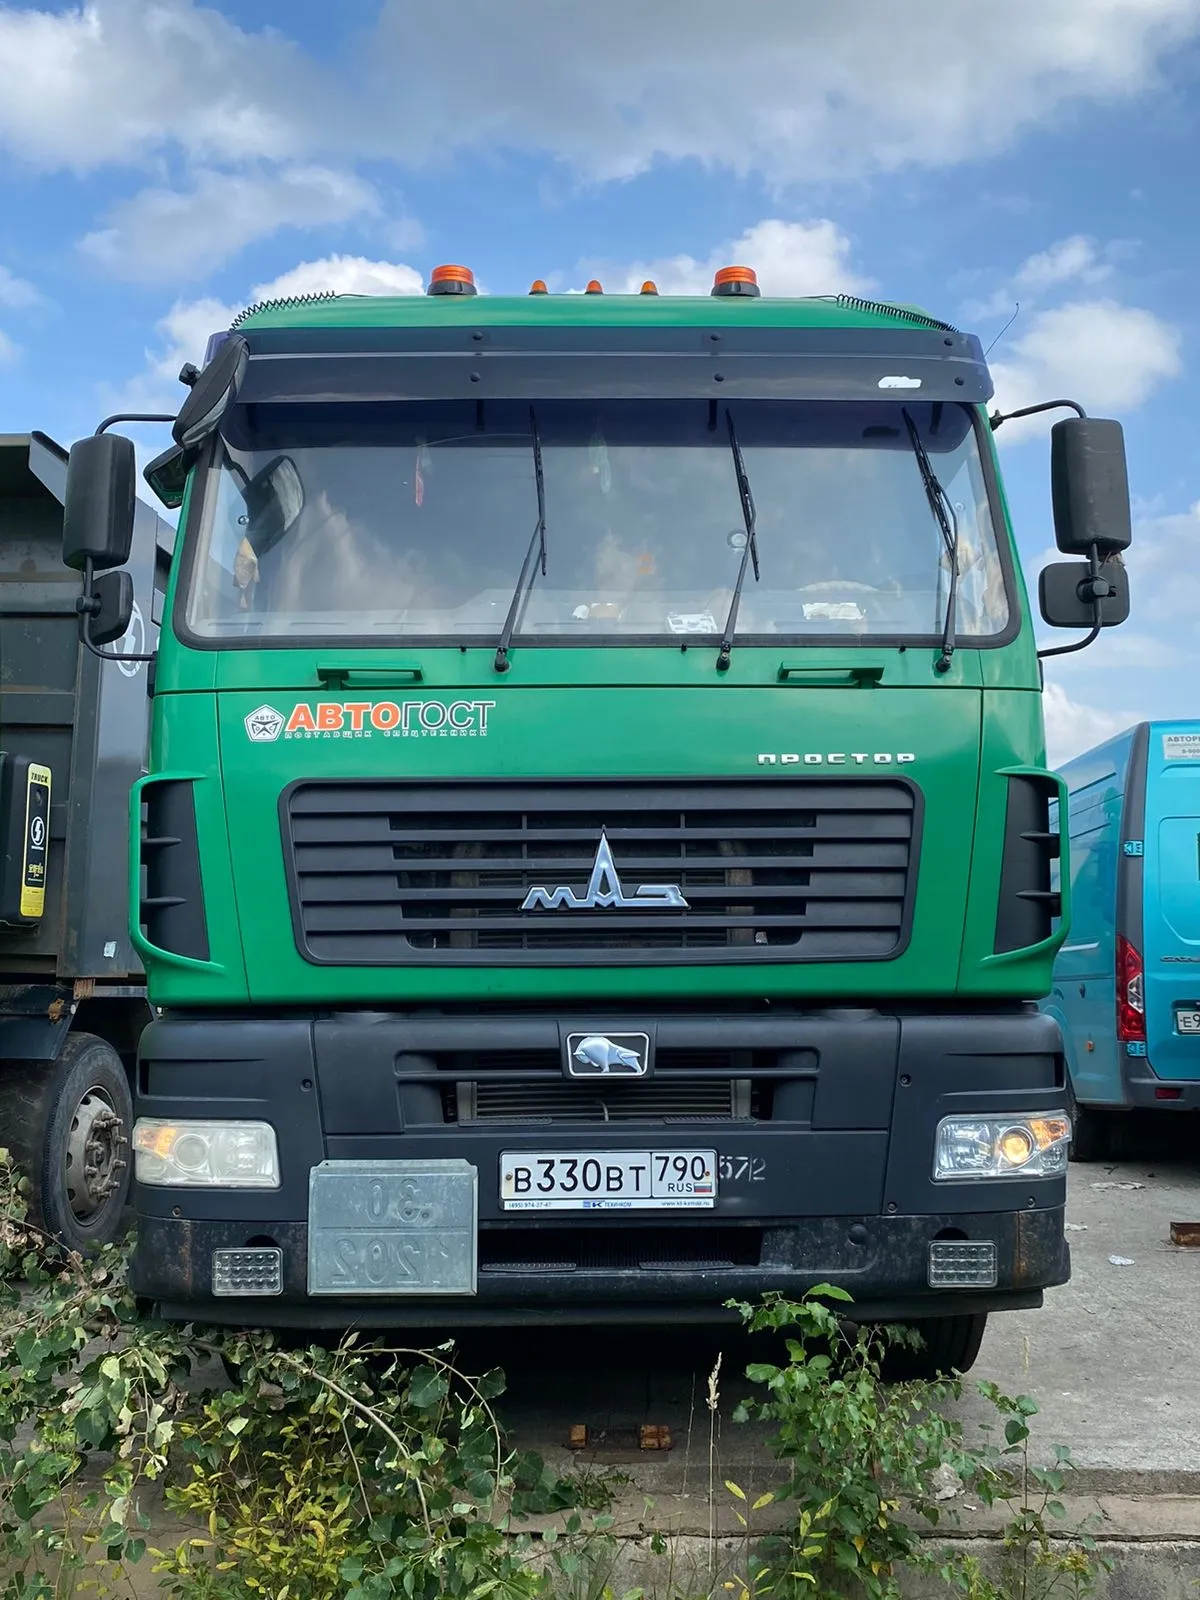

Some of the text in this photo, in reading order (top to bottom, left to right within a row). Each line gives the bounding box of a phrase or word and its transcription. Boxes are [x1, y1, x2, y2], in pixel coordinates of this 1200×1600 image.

[284, 701, 496, 731] АВТОГОСТ
[284, 729, 488, 740] ПОСТАВЩИК СПЕЦТЕХНИКИ
[757, 752, 916, 766] ПРОСТОР
[520, 824, 690, 910] МАЗ
[513, 1155, 706, 1193] В330ВТ 790
[667, 1182, 693, 1193] RUS
